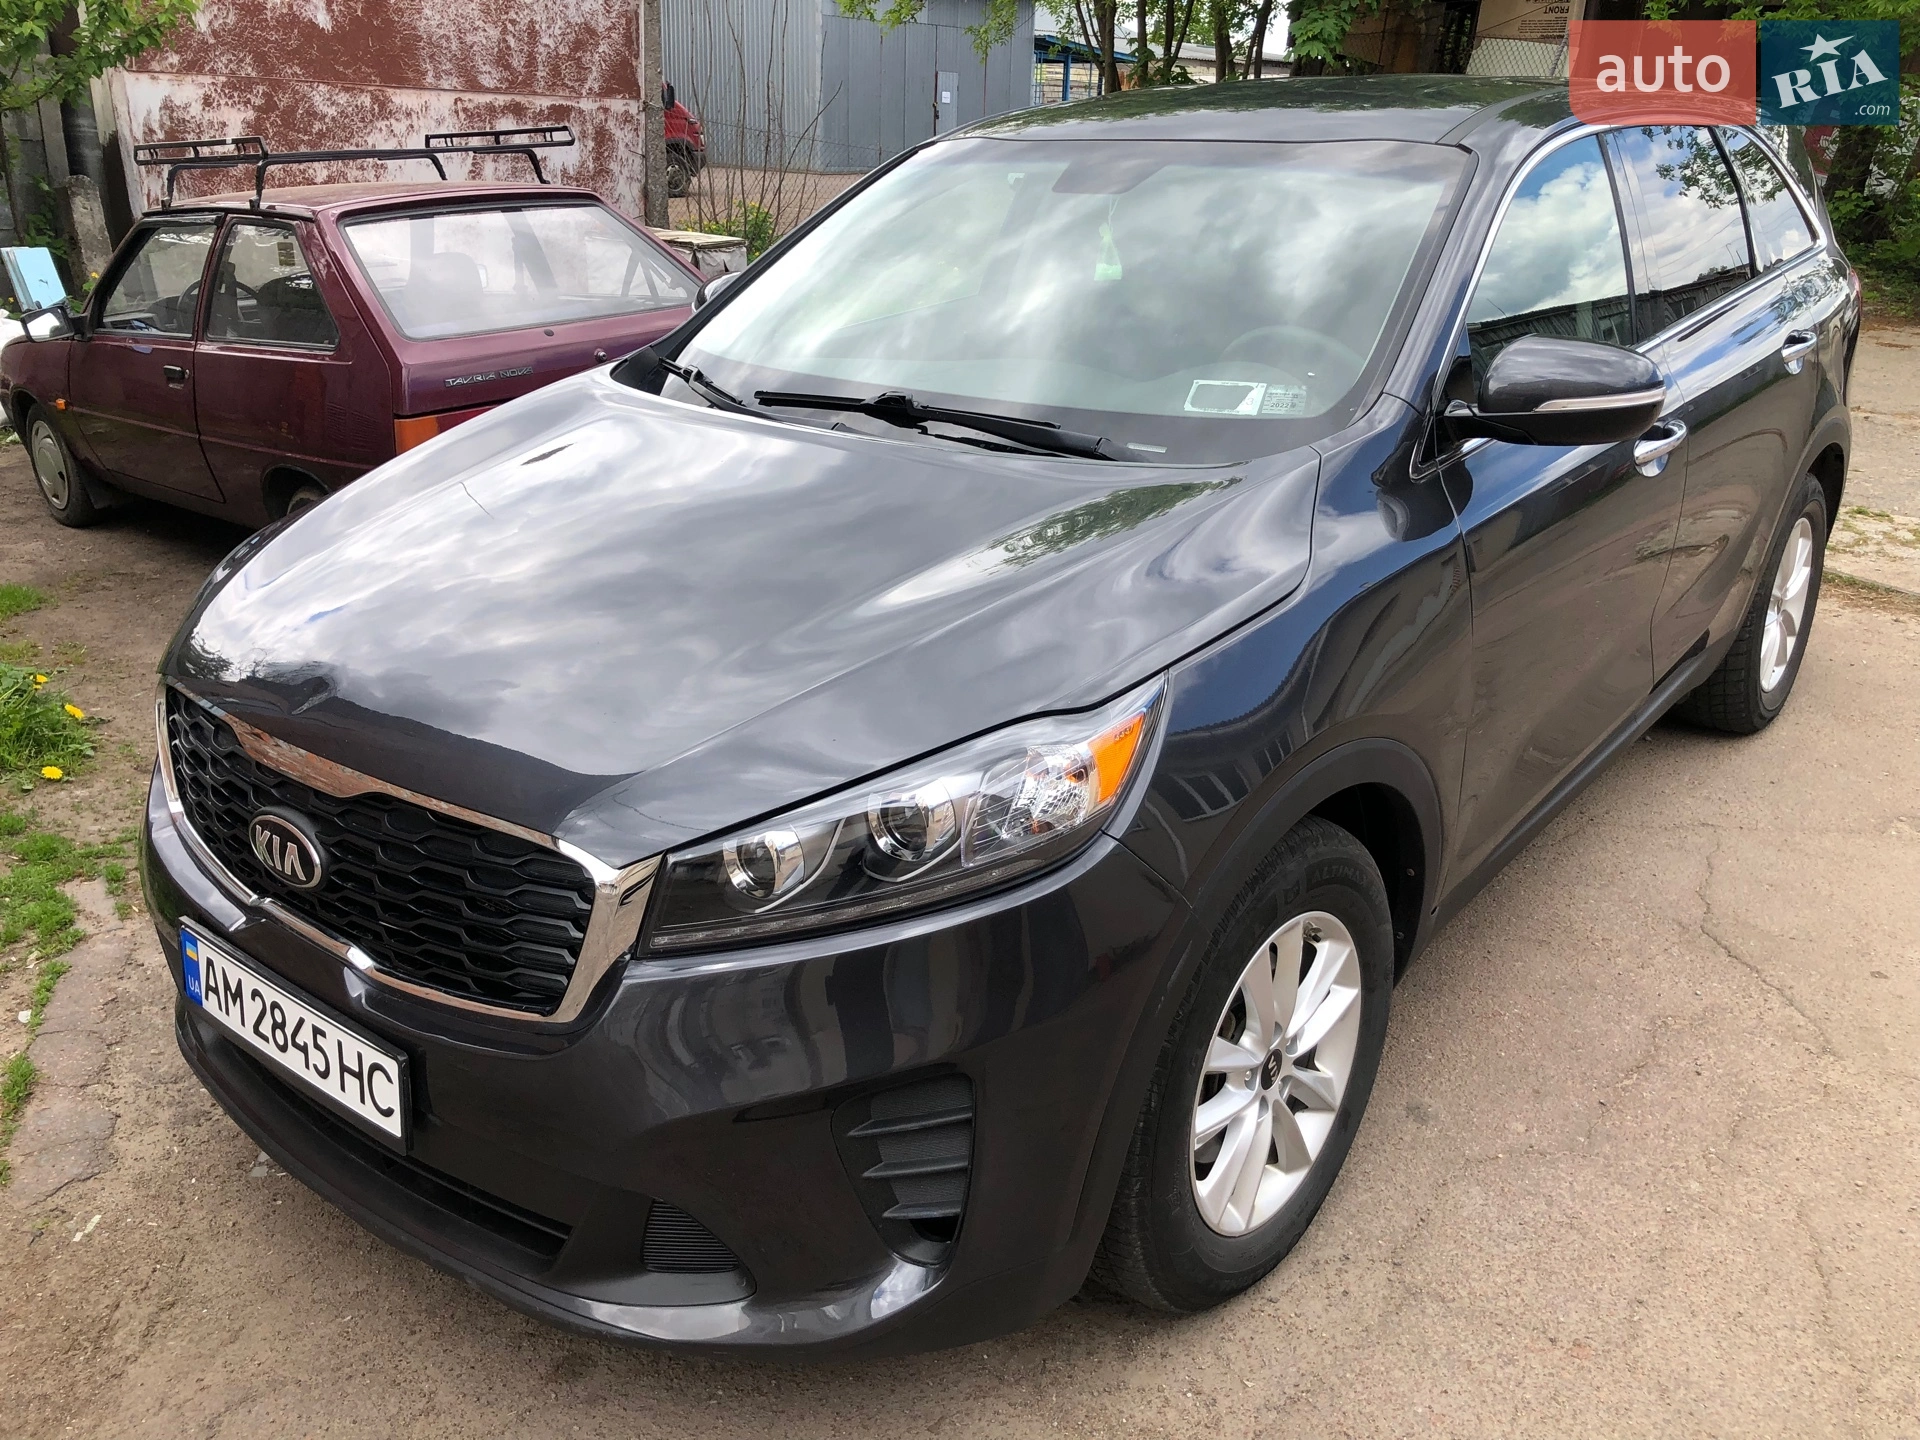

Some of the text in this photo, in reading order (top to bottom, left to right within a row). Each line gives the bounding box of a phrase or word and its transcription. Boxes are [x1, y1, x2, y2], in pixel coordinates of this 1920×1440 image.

[1543, 6, 1570, 14] FRONT
[445, 366, 533, 387] TAVRIA NOVA
[255, 824, 307, 881] KIA
[188, 974, 200, 996] UA
